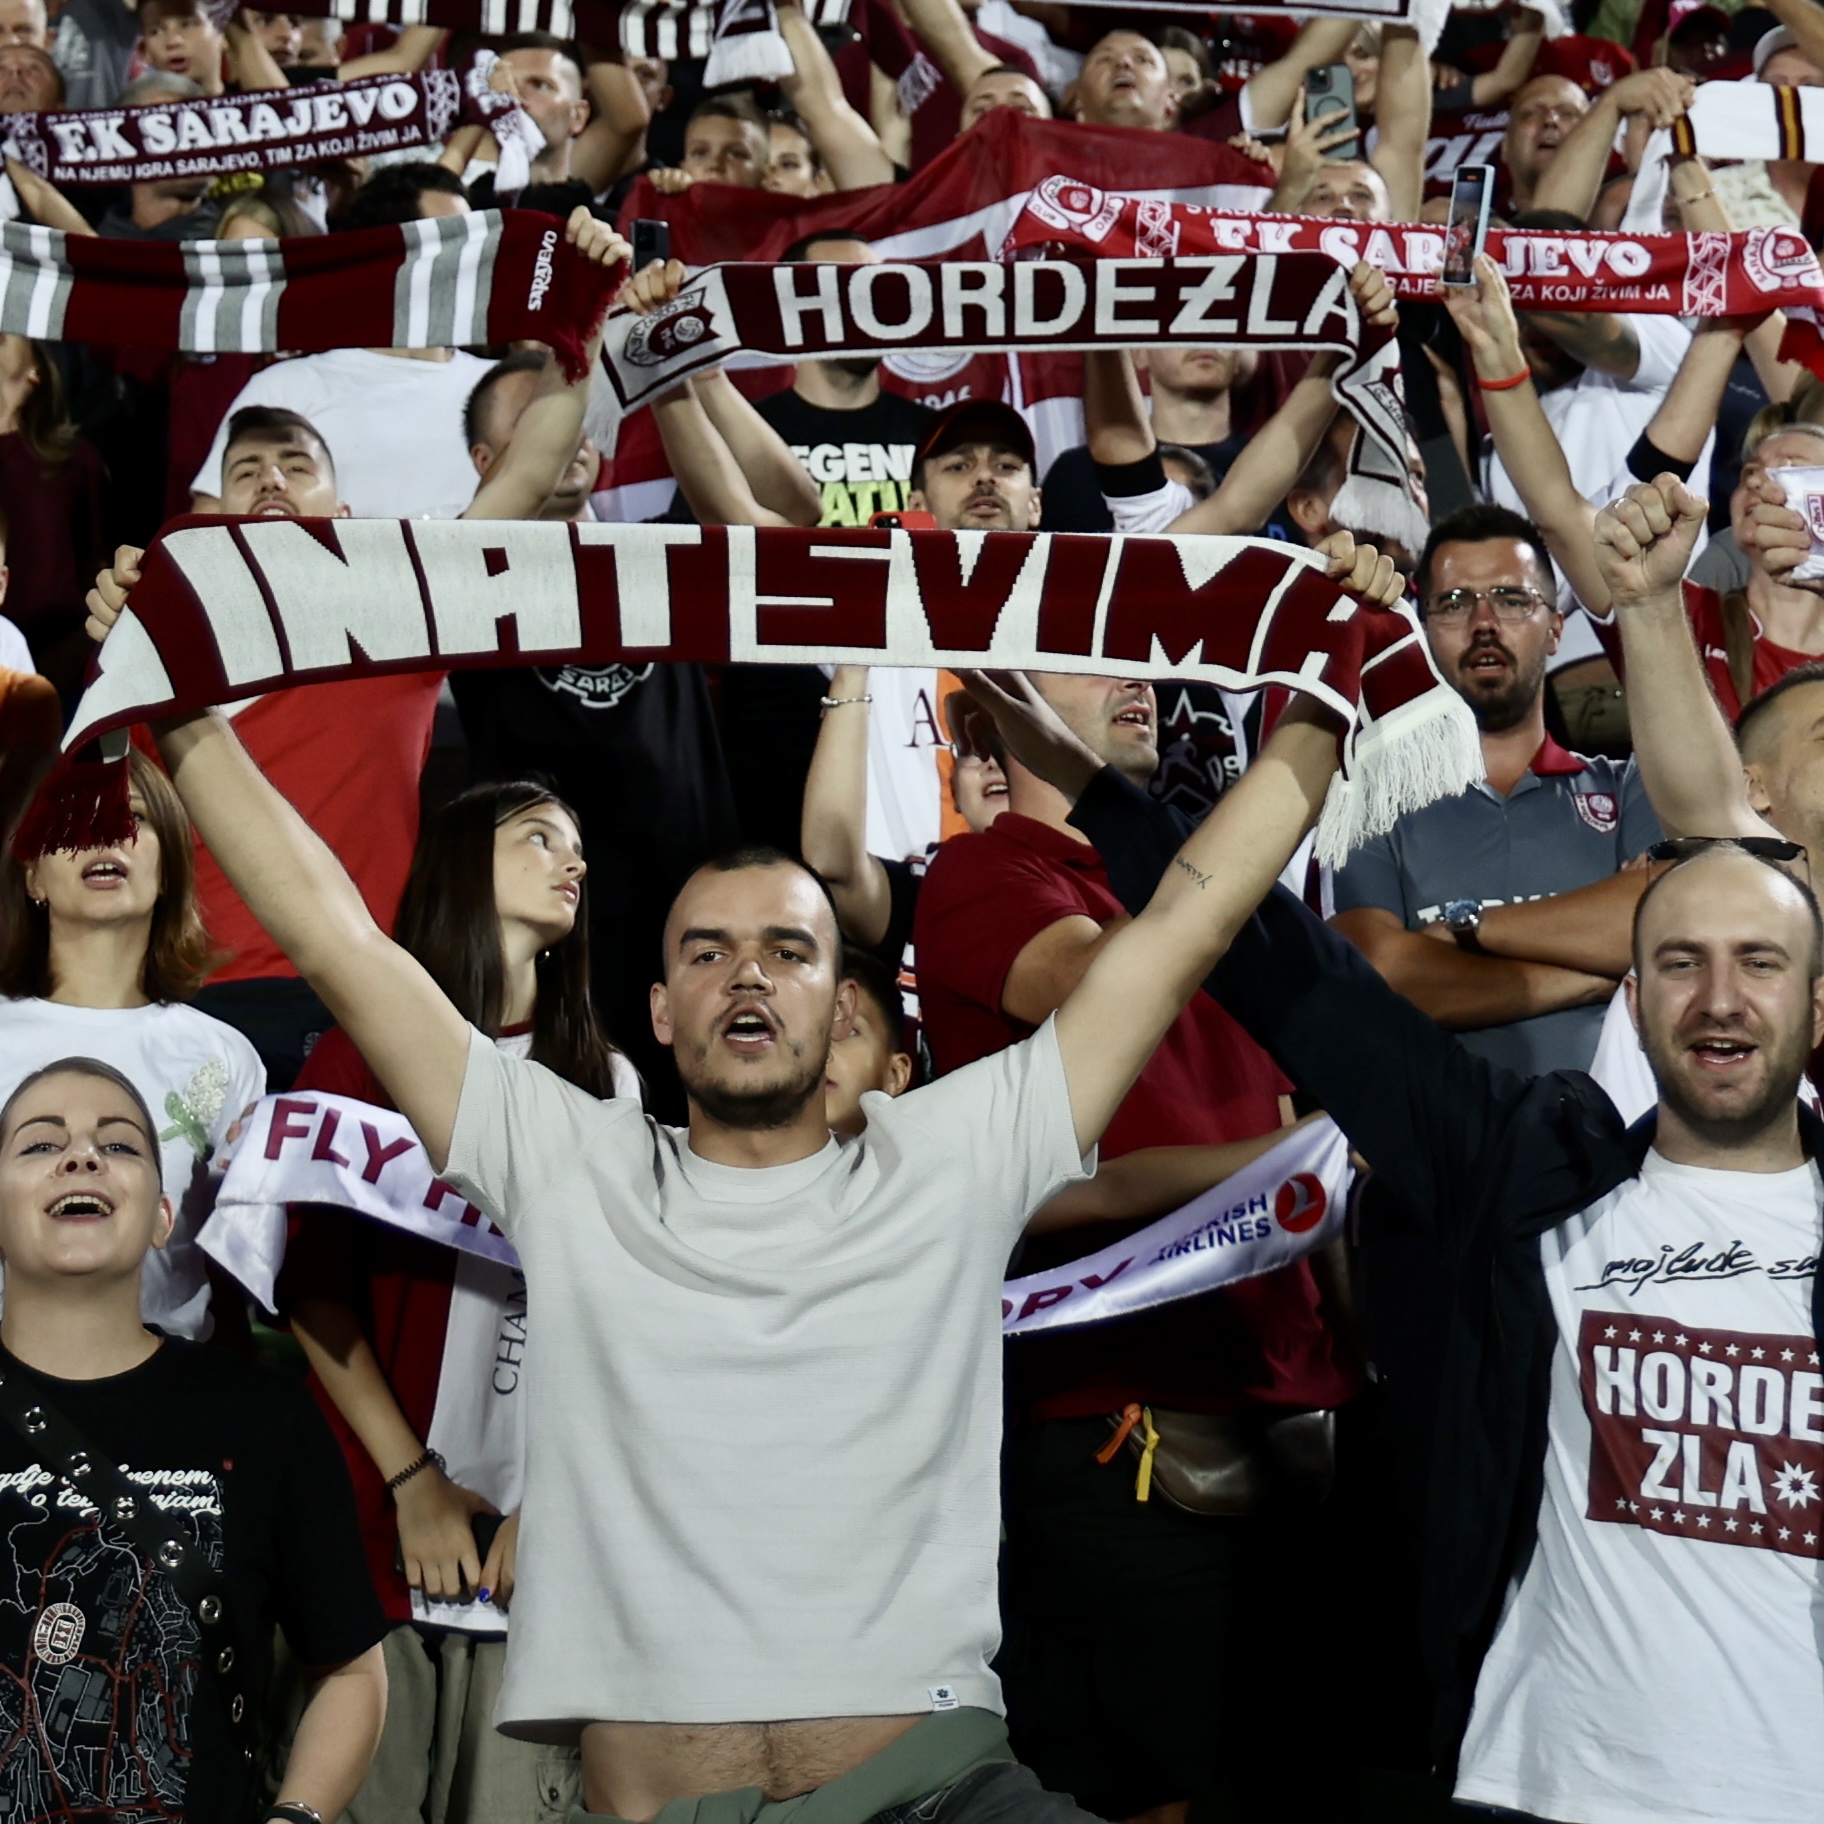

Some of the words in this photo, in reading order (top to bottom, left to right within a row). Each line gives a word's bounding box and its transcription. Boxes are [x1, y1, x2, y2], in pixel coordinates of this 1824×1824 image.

[53, 165, 77, 182] NA
[79, 163, 133, 182] NJEMU
[134, 161, 174, 180] IGRA
[266, 149, 293, 168] TIM
[295, 144, 318, 164] ZA
[319, 139, 357, 159] KOJI
[399, 126, 424, 144] JA
[138, 80, 420, 158] SARAJEVO
[527, 229, 558, 312] SARAJEVO
[1509, 284, 1536, 302] ZA
[1538, 283, 1589, 303] KOJI
[1637, 284, 1671, 302] JA
[262, 1096, 419, 1184] FLY
[1639, 1427, 1772, 1516] ZLA
